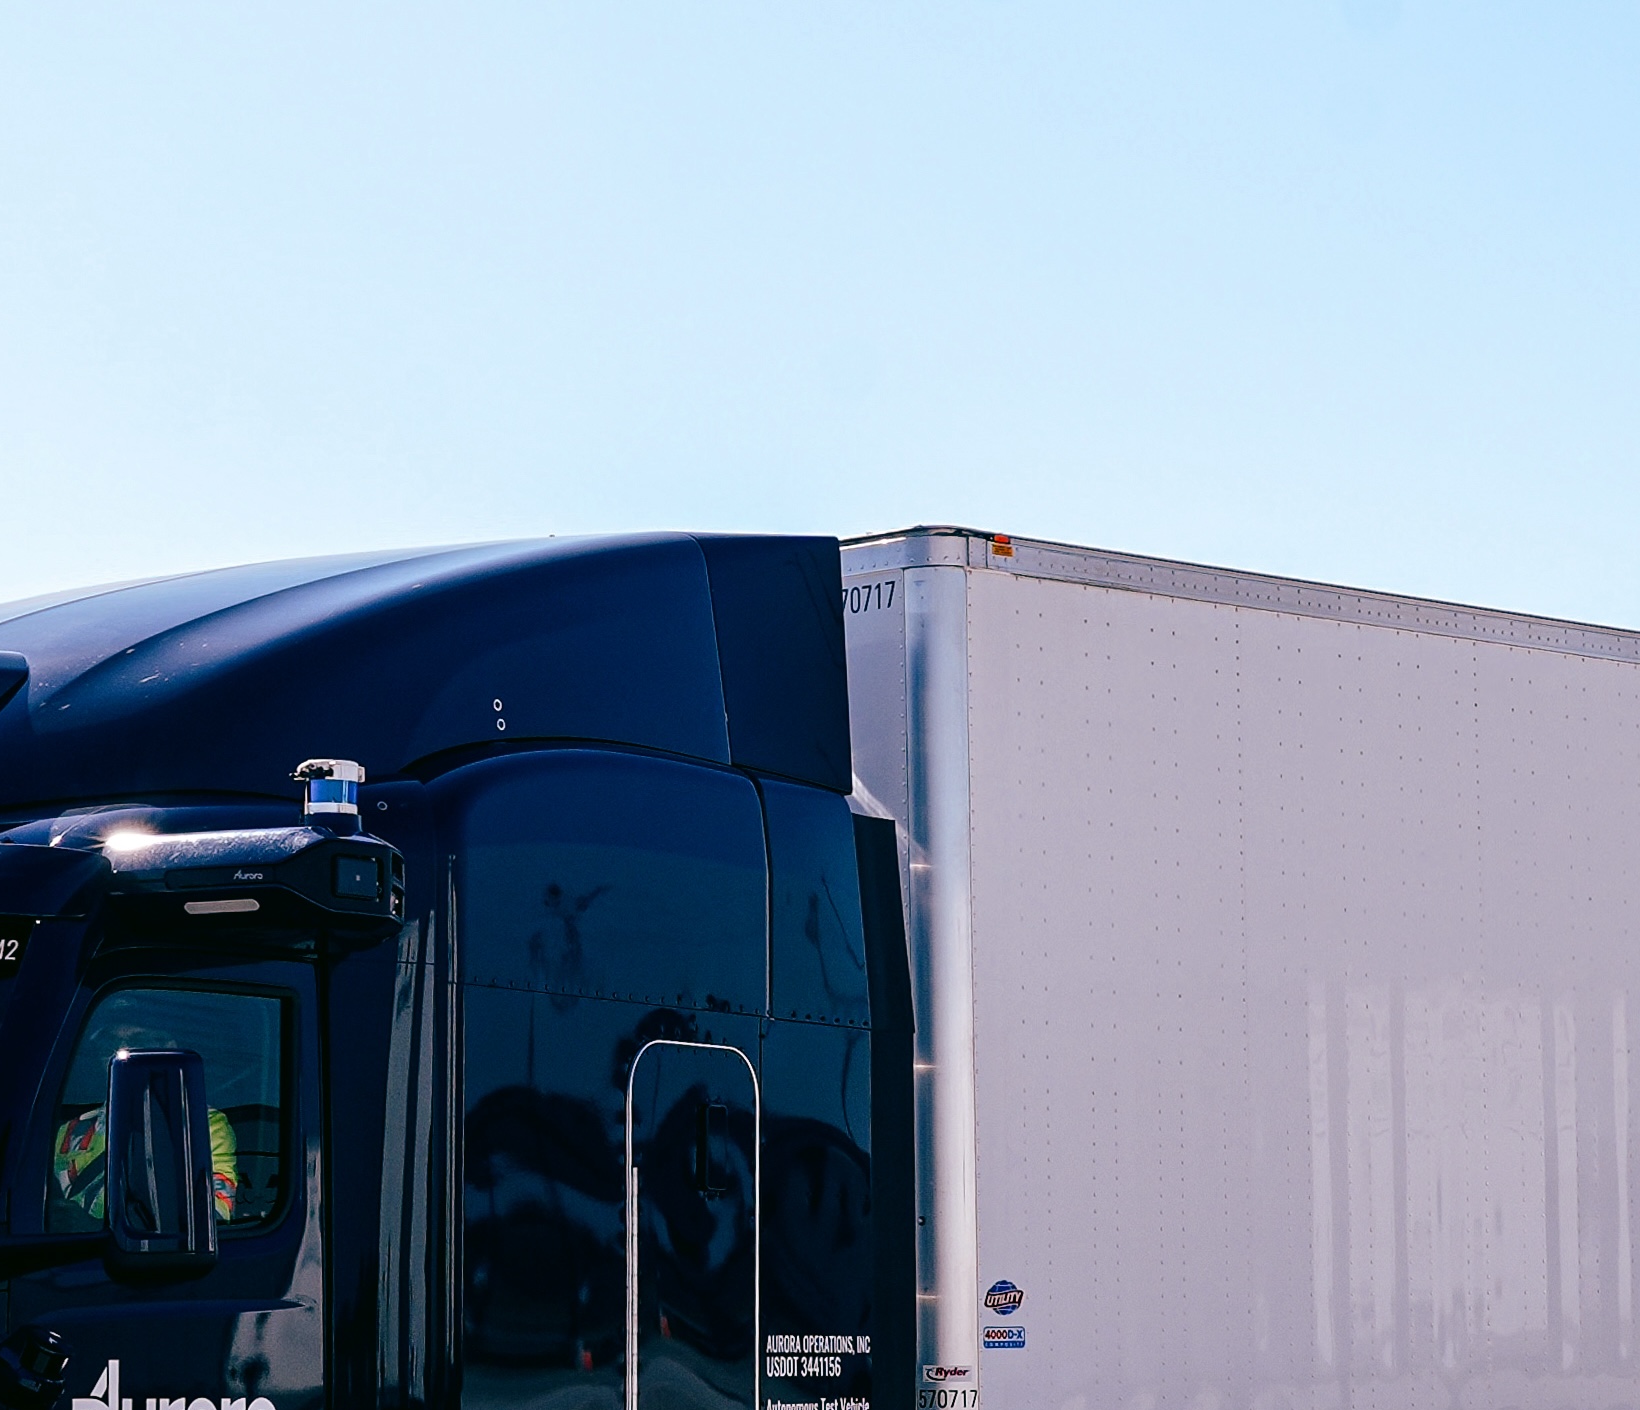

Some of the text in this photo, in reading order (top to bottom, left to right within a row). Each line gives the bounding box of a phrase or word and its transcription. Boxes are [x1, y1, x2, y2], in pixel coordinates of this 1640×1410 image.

[233, 869, 264, 880] Aurora
[986, 1291, 1022, 1306] UTILITY
[985, 1329, 1023, 1340] 4000D-X
[766, 1335, 871, 1355] AURORA OPERATIONS, INC
[766, 1356, 842, 1377] USDOT 3441156
[935, 1367, 970, 1378] Ryder
[919, 1389, 978, 1409] 570717
